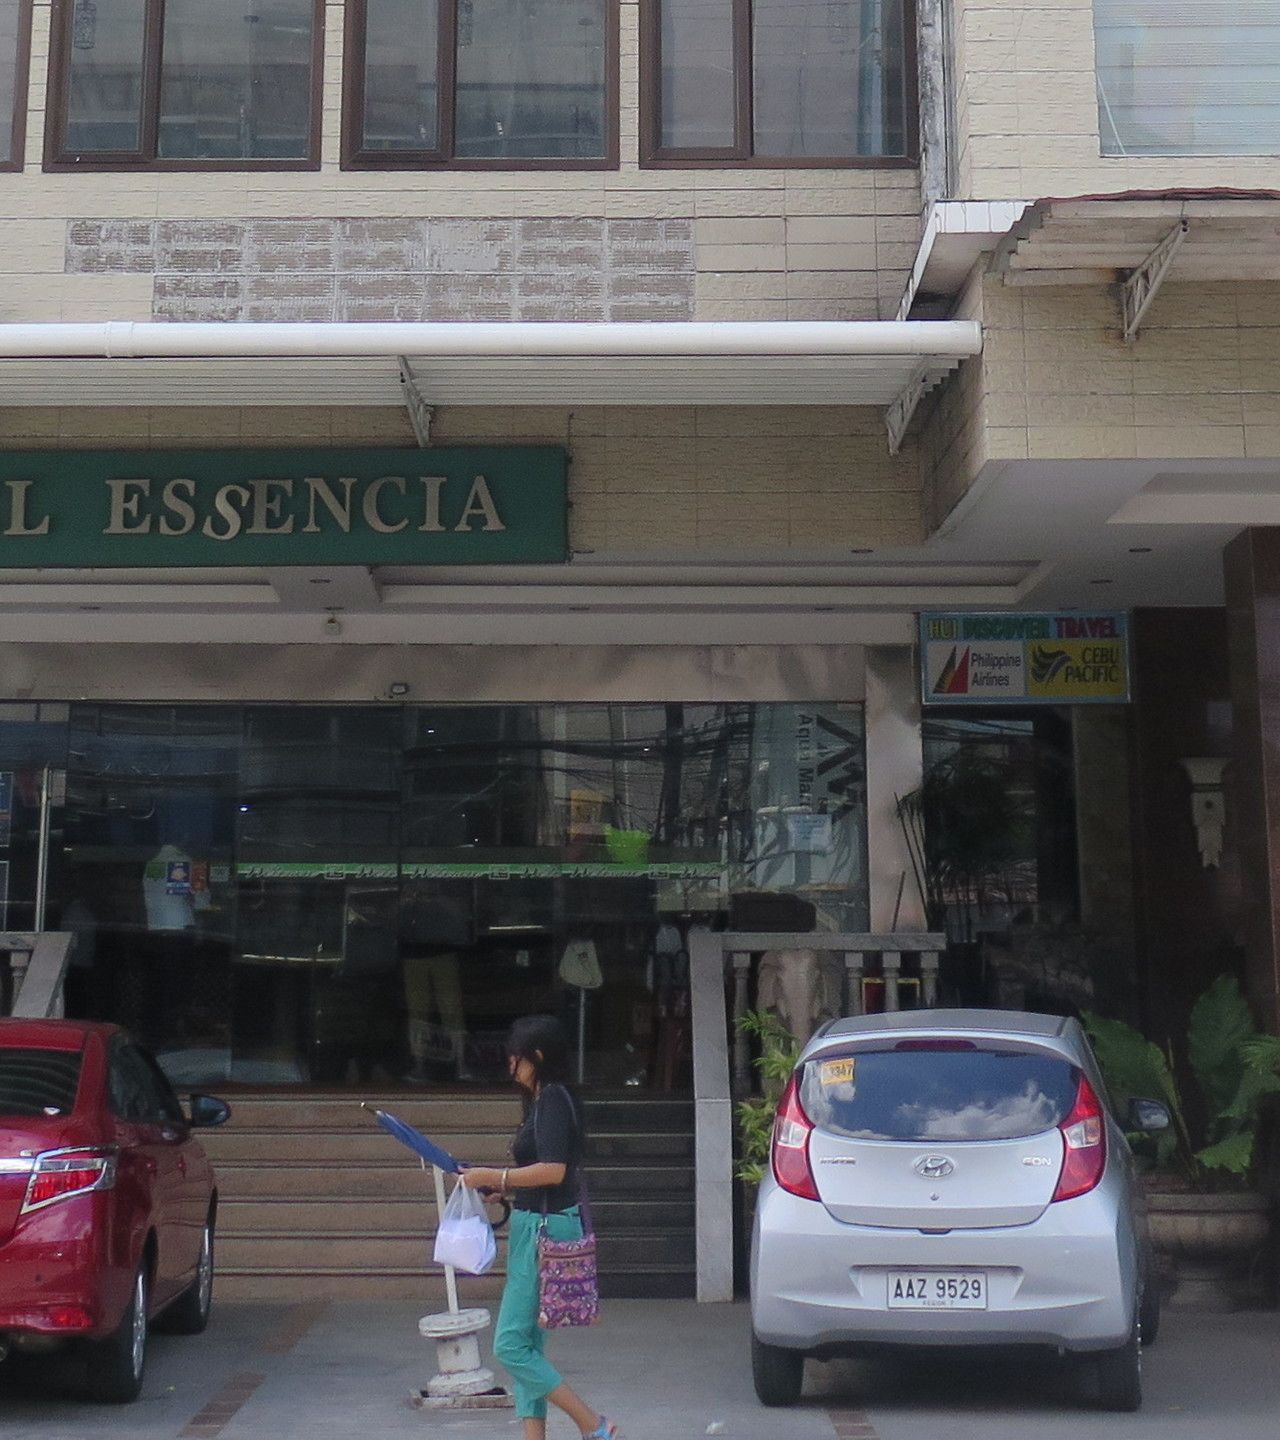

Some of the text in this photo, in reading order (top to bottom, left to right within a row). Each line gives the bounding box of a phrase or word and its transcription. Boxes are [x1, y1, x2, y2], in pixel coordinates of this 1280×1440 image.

[102, 474, 507, 541] ESSENCIA
[1053, 616, 1120, 638] TRAVEL
[971, 652, 1021, 671] Philippine
[1081, 647, 1120, 664] CEBU
[972, 672, 1010, 687] Airlines
[1064, 665, 1119, 684] PACIFIC
[1022, 1157, 1052, 1166] EON
[893, 1278, 981, 1299] AAZ 9529
